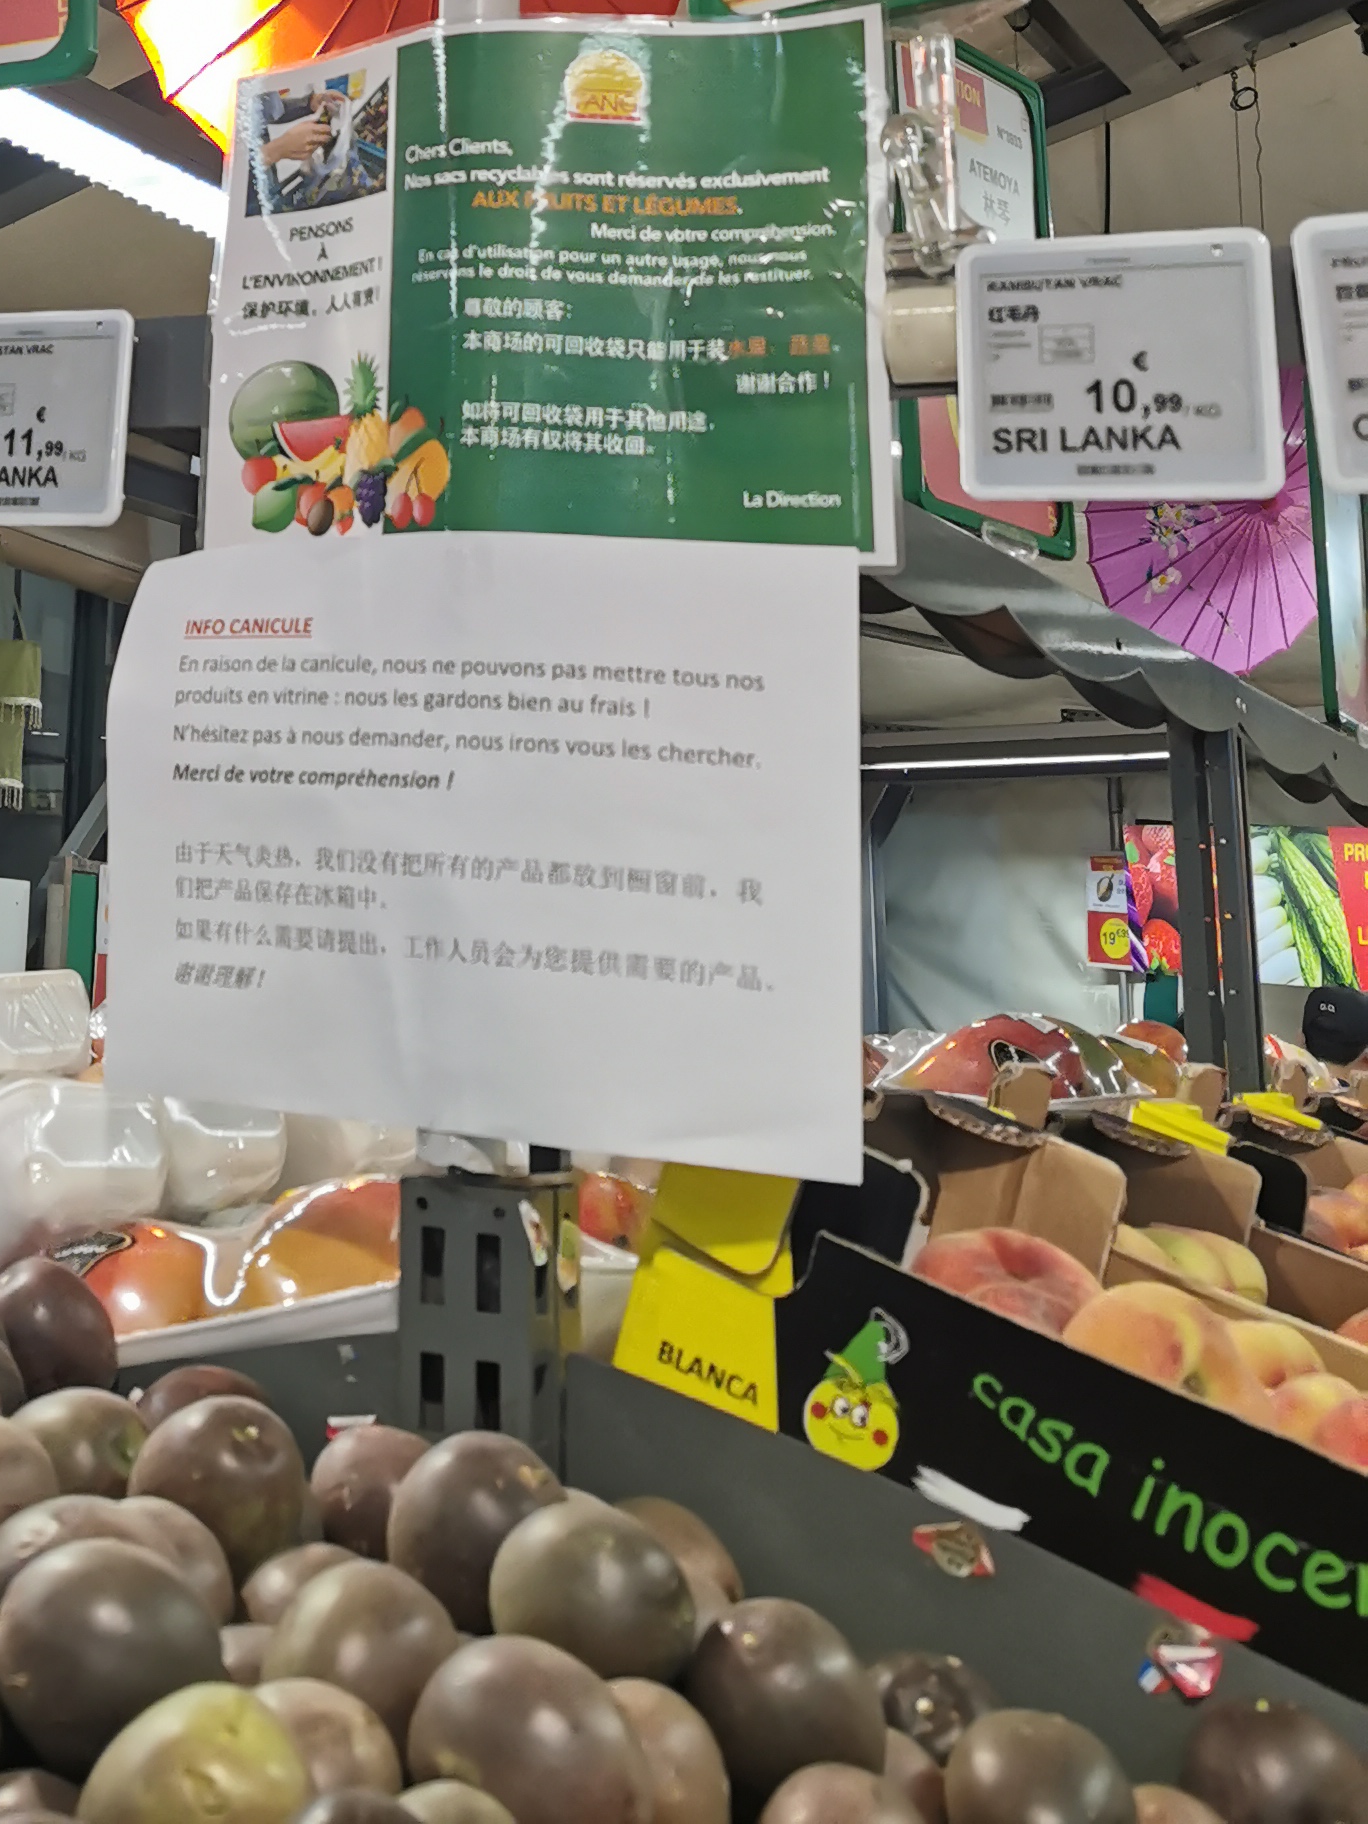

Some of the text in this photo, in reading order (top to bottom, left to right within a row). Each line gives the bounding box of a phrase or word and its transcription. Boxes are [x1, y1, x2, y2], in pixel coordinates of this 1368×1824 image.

[448, 137, 513, 156] Clients,
[434, 169, 467, 185] sacs
[573, 170, 615, 186] sont
[617, 170, 697, 190] réservés
[699, 166, 830, 189] exclusivement
[969, 157, 1020, 196] ATEMOYA
[471, 189, 520, 209] AUX
[601, 192, 629, 214] ET
[289, 217, 354, 242] PENSONS
[590, 222, 637, 241] Merci
[639, 225, 663, 242] de
[665, 227, 709, 243] votre
[558, 248, 597, 265] pour
[600, 250, 621, 266] un
[625, 253, 668, 268] autre
[478, 263, 493, 278] le
[540, 266, 562, 282] de
[567, 270, 604, 283] vous
[718, 270, 741, 287] les
[992, 423, 1182, 454] SRI LANKA
[742, 489, 842, 509] La Direction
[184, 617, 314, 636] INFO CANICULE
[178, 654, 766, 692] En raison de la canicule, nous ne pouvons pas mettre tous nos
[174, 686, 636, 718] produits en vitrine nous les gardons bien au frais
[173, 723, 249, 743] N'hésitez
[252, 727, 282, 747] pas
[286, 725, 297, 744] à
[301, 729, 344, 747] nous
[348, 726, 451, 752] demander,
[455, 732, 504, 752] nous
[509, 733, 560, 755] irons
[565, 738, 616, 759] vous
[621, 737, 652, 761] les
[172, 763, 440, 790] Merci de votre compréhension
[658, 1340, 760, 1407] BLANCA
[972, 1373, 1111, 1497] casa
